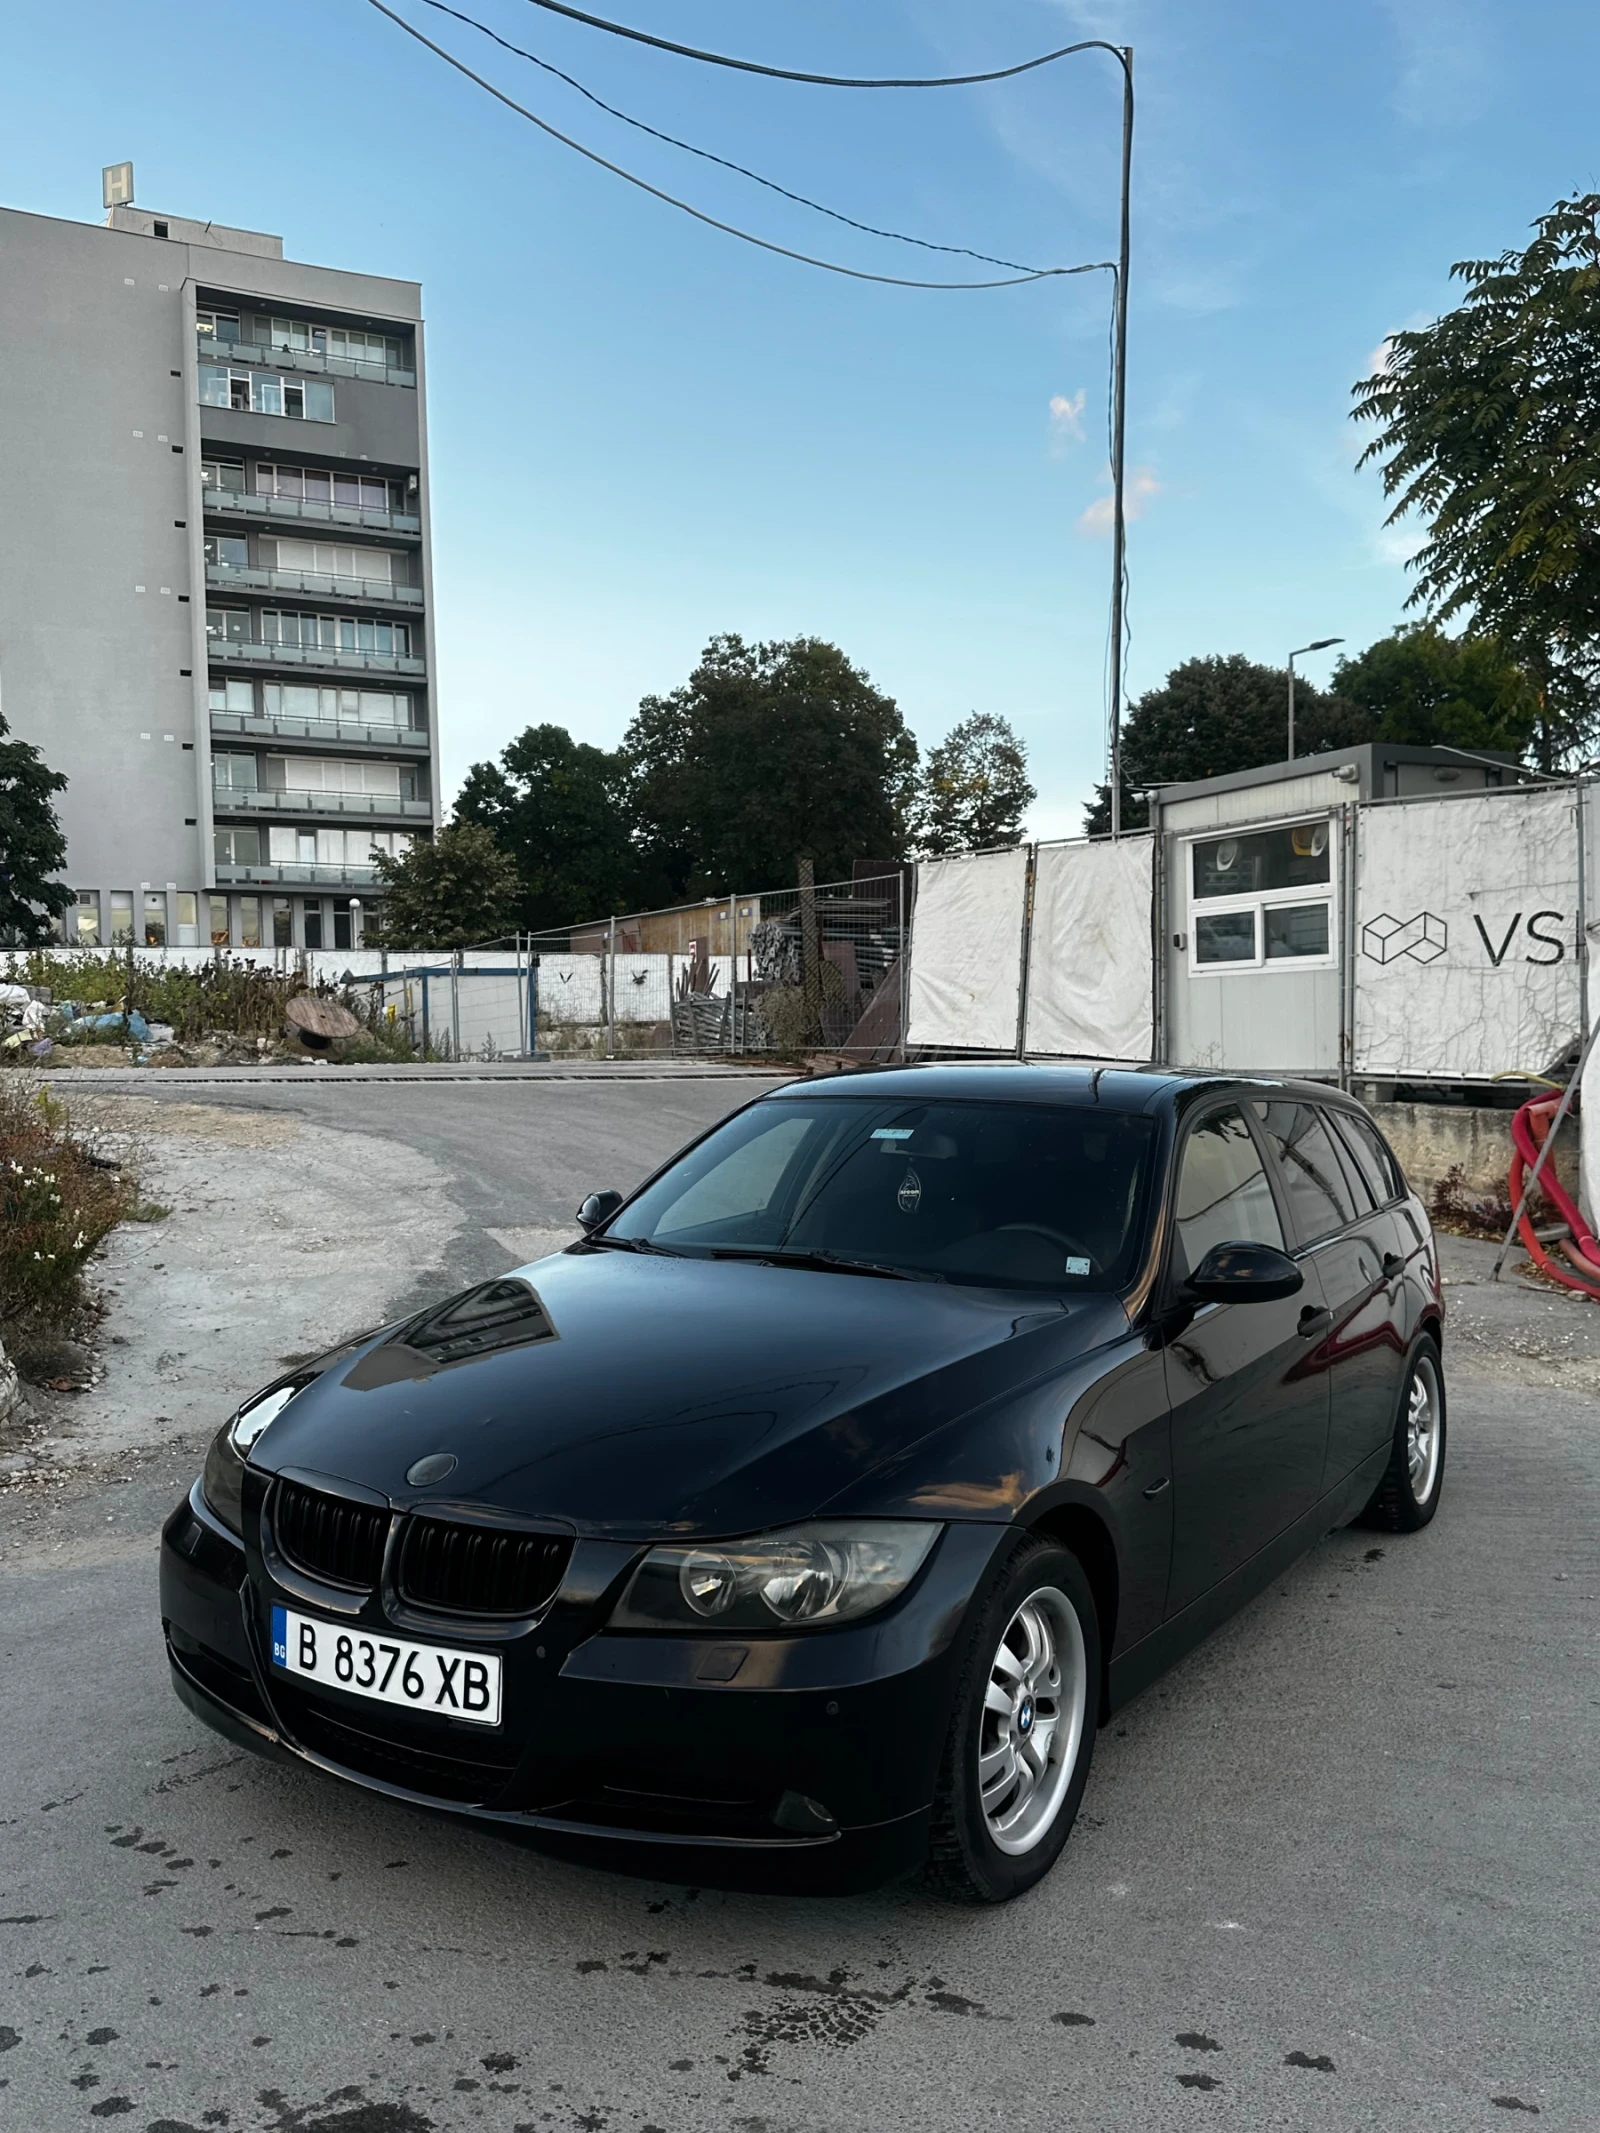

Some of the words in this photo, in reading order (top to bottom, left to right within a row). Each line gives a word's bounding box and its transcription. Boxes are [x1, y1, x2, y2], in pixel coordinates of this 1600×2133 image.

[106, 166, 128, 203] H
[274, 1641, 286, 1659] BG
[300, 1622, 316, 1670] B
[335, 1635, 424, 1699] 8376
[435, 1655, 490, 1711] XB
